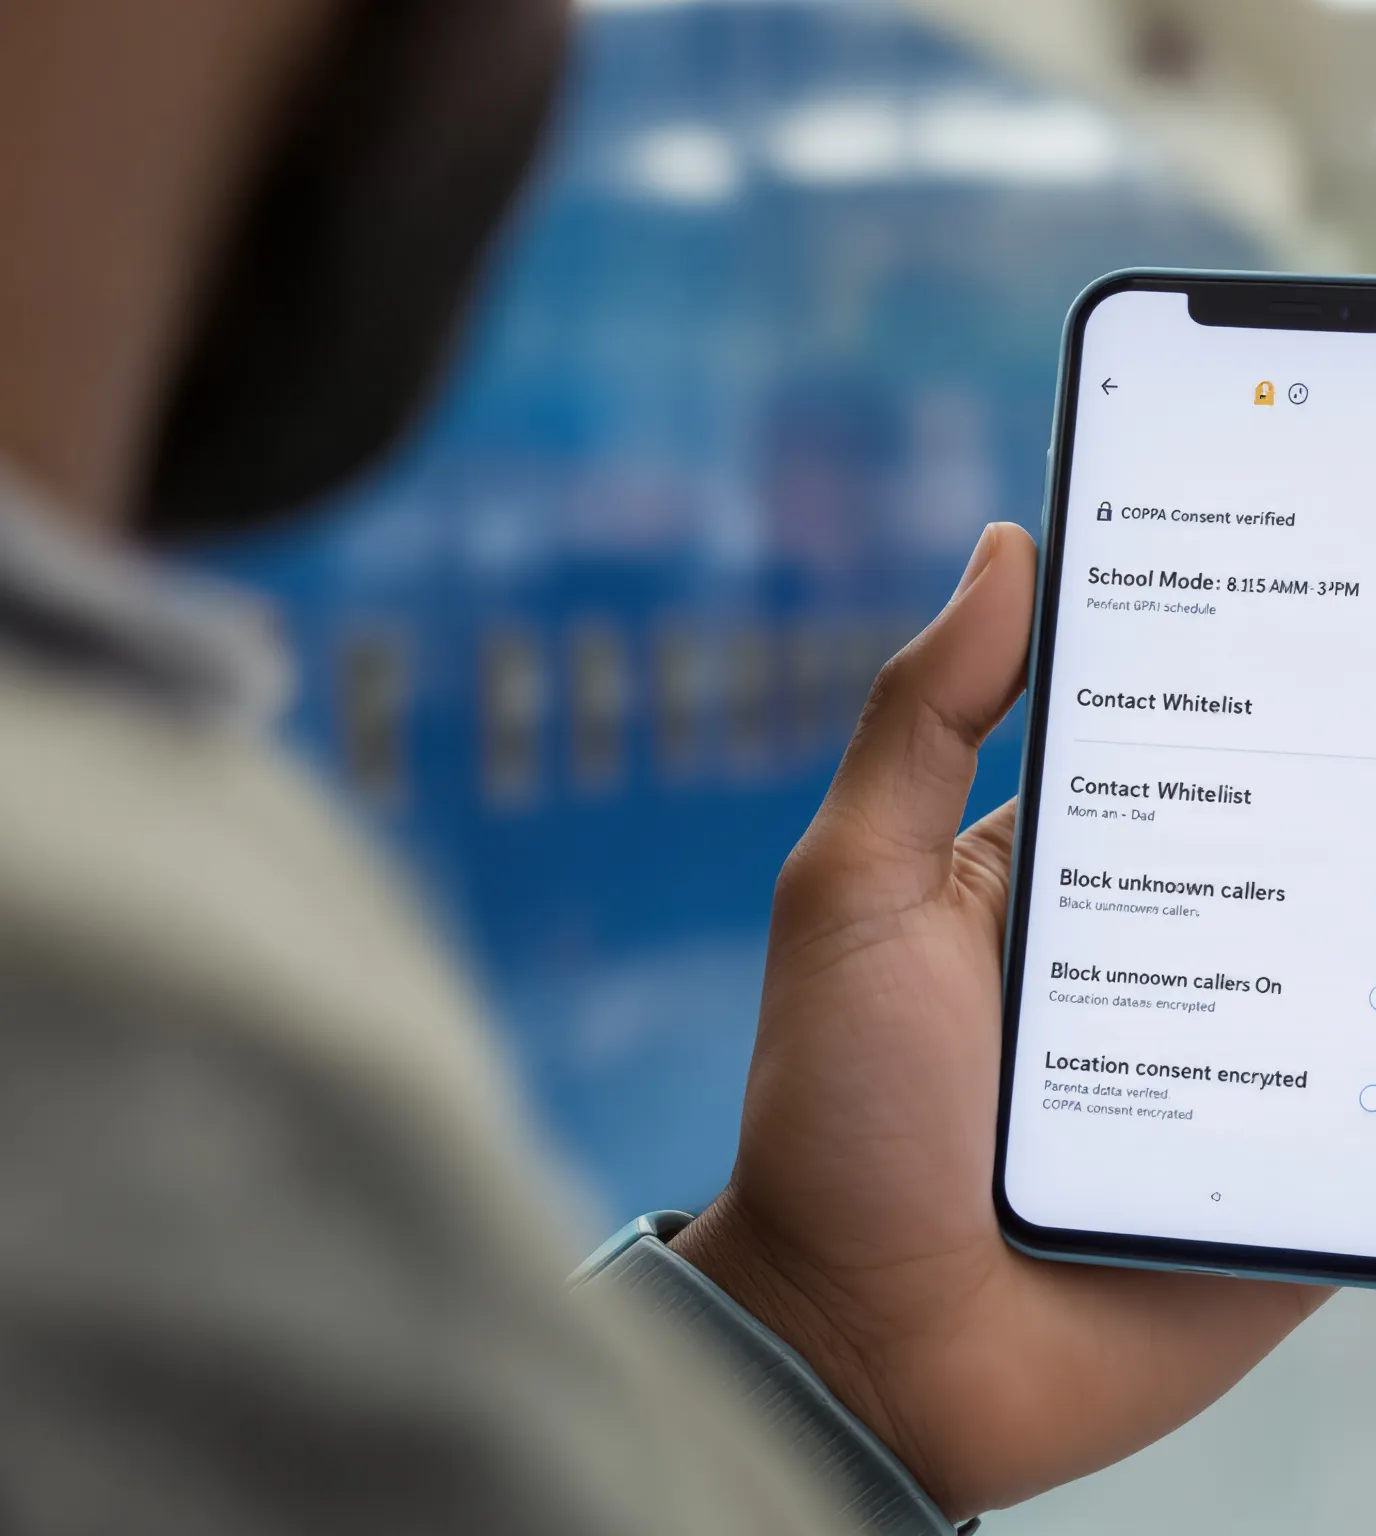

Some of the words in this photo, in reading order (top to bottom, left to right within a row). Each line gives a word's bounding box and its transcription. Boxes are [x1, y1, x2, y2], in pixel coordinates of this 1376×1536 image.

[1121, 507, 1166, 520] COPPA
[1171, 509, 1231, 524] Consent
[1236, 511, 1296, 527] verified
[1088, 567, 1154, 587] School
[1159, 571, 1221, 590] Mode:
[1077, 688, 1156, 710] Contact
[1163, 693, 1253, 715] Whitelist
[1070, 776, 1150, 798] Contact
[1067, 805, 1097, 818] Mom
[1131, 809, 1155, 821] Dad
[1060, 868, 1113, 889] Block
[1221, 881, 1285, 901] callers
[1050, 962, 1101, 982] Block
[1193, 973, 1250, 992] callers
[1255, 977, 1282, 994] On
[1045, 1051, 1129, 1075] Location
[1136, 1062, 1211, 1081] consent
